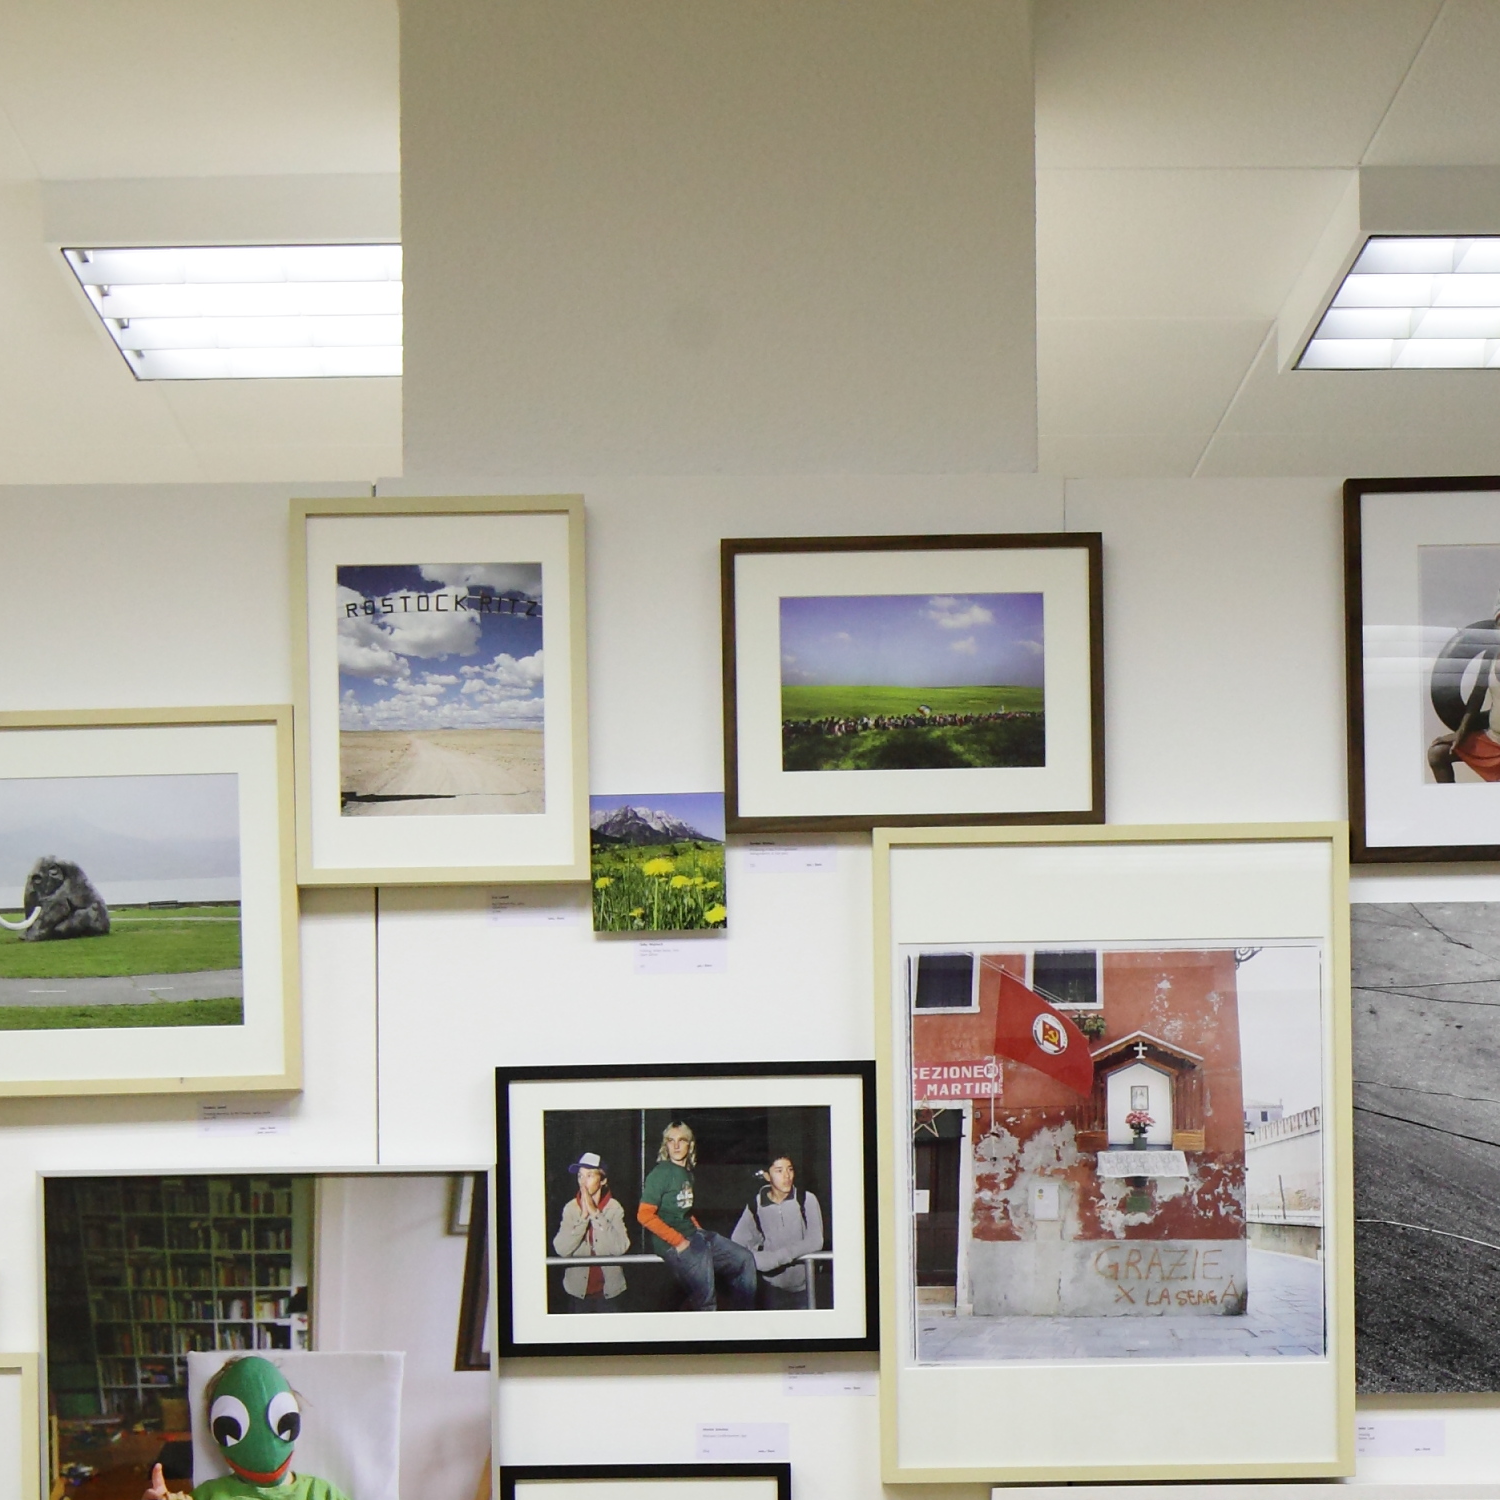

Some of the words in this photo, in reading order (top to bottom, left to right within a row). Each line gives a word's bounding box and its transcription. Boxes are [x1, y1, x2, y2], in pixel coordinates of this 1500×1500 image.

[346, 595, 468, 618] ROSTOCK
[480, 594, 538, 617] RITZ
[1095, 1246, 1223, 1281] GRAZIE
[1114, 1285, 1136, 1304] X
[1146, 1288, 1171, 1306] LA
